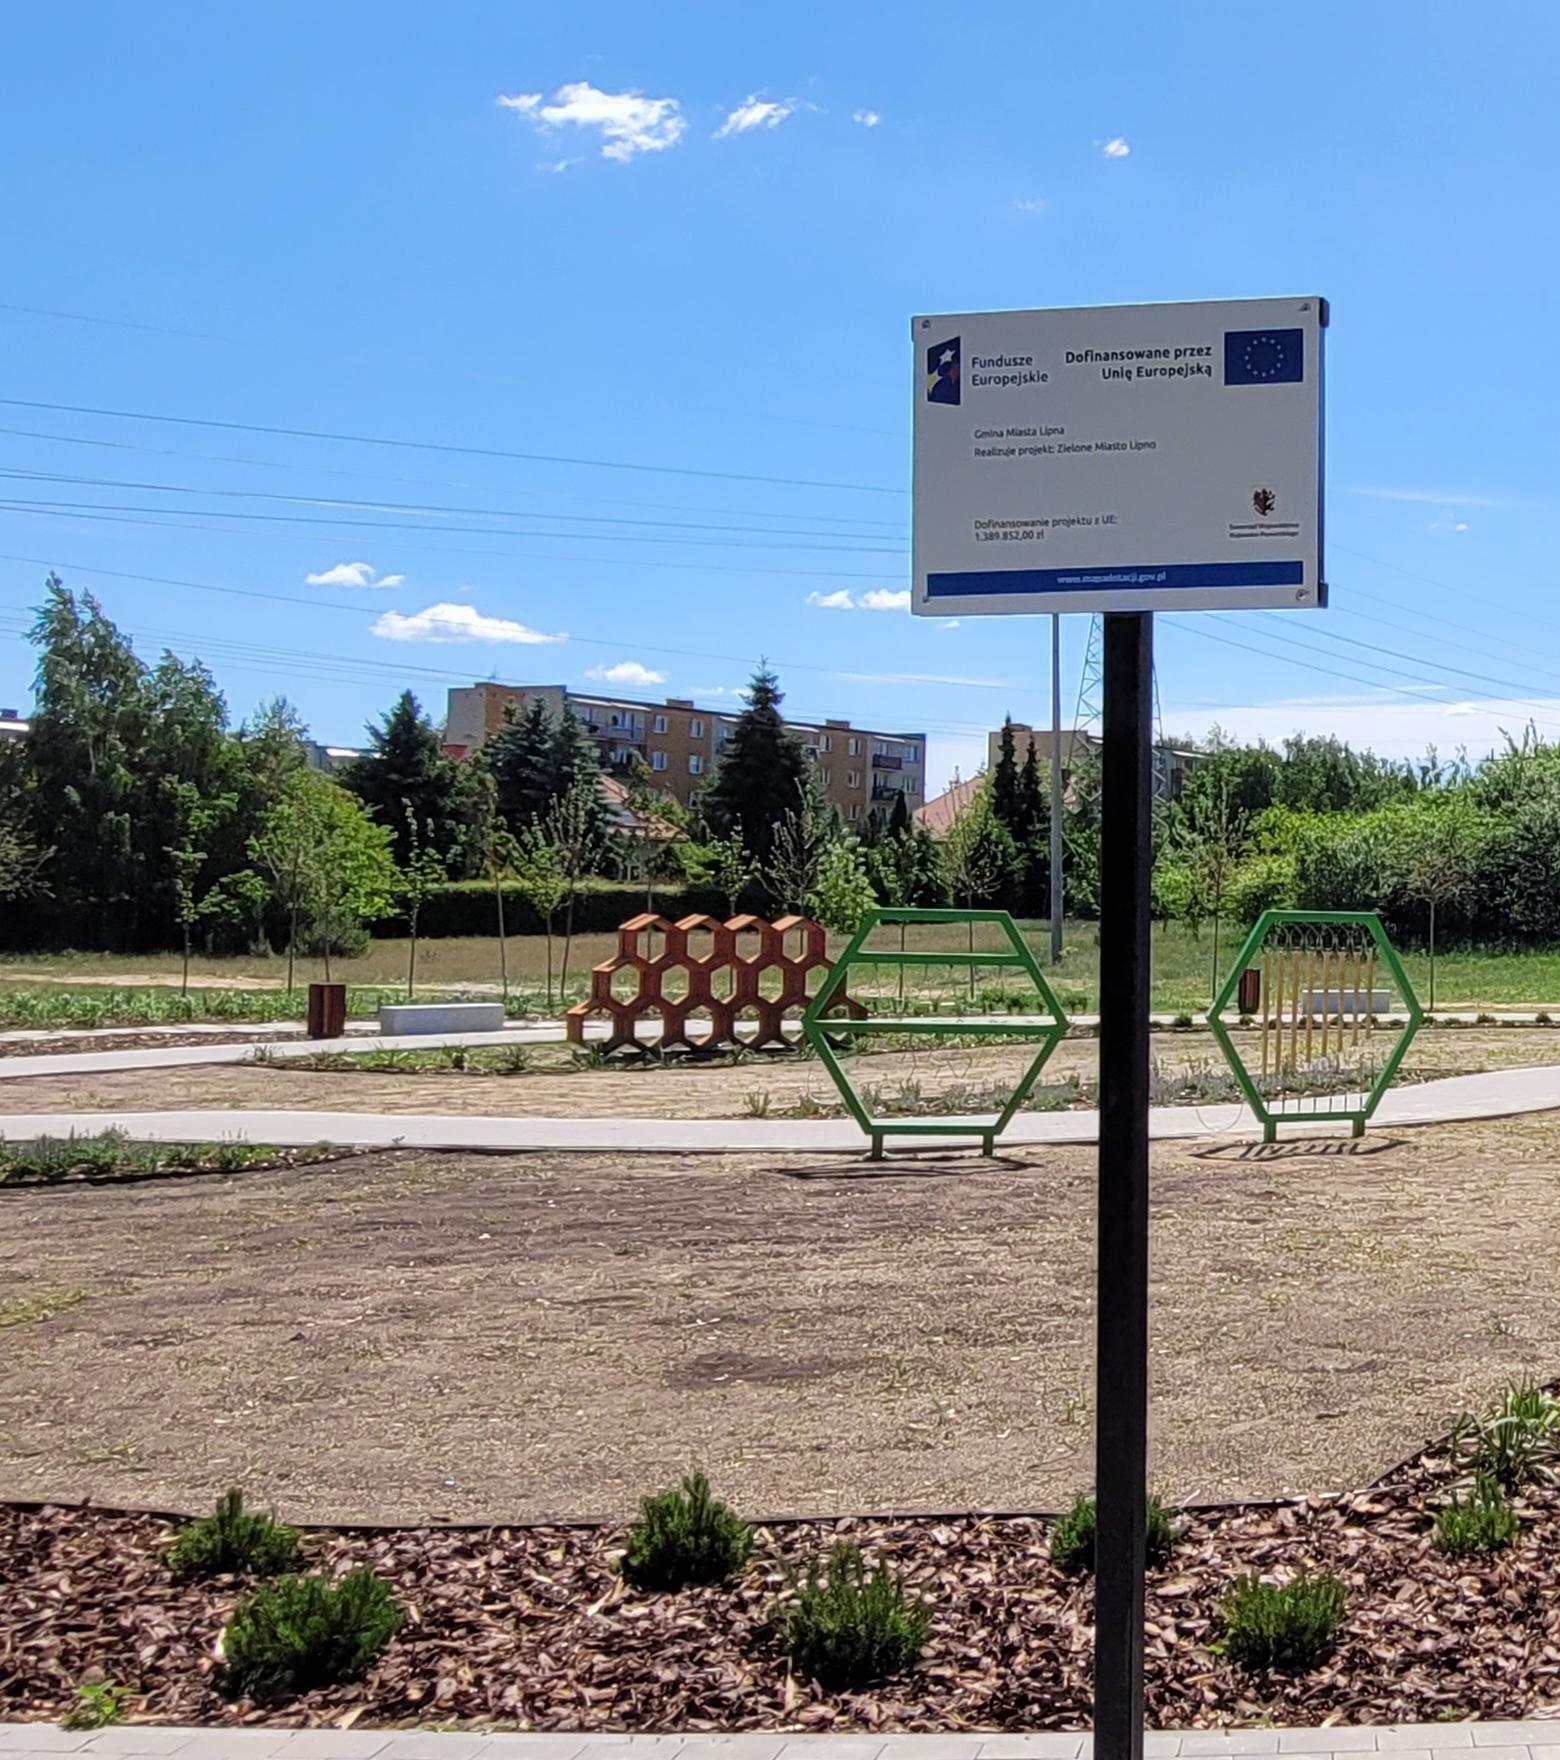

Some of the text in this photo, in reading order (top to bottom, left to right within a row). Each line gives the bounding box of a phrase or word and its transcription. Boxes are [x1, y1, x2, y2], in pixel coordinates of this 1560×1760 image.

[971, 355, 1033, 369] Fundusze
[1065, 346, 1213, 364] Dofinansowane przez
[971, 371, 1049, 388] Europejskie
[1101, 363, 1213, 382] Unię Europejską
[974, 426, 1065, 439] Gmina Miasta Lipna
[974, 440, 1157, 458] Realizuje projekt: Zielone Miasto Lipno
[974, 518, 1050, 530] Dofinansowanie
[1051, 515, 1093, 528] projektu
